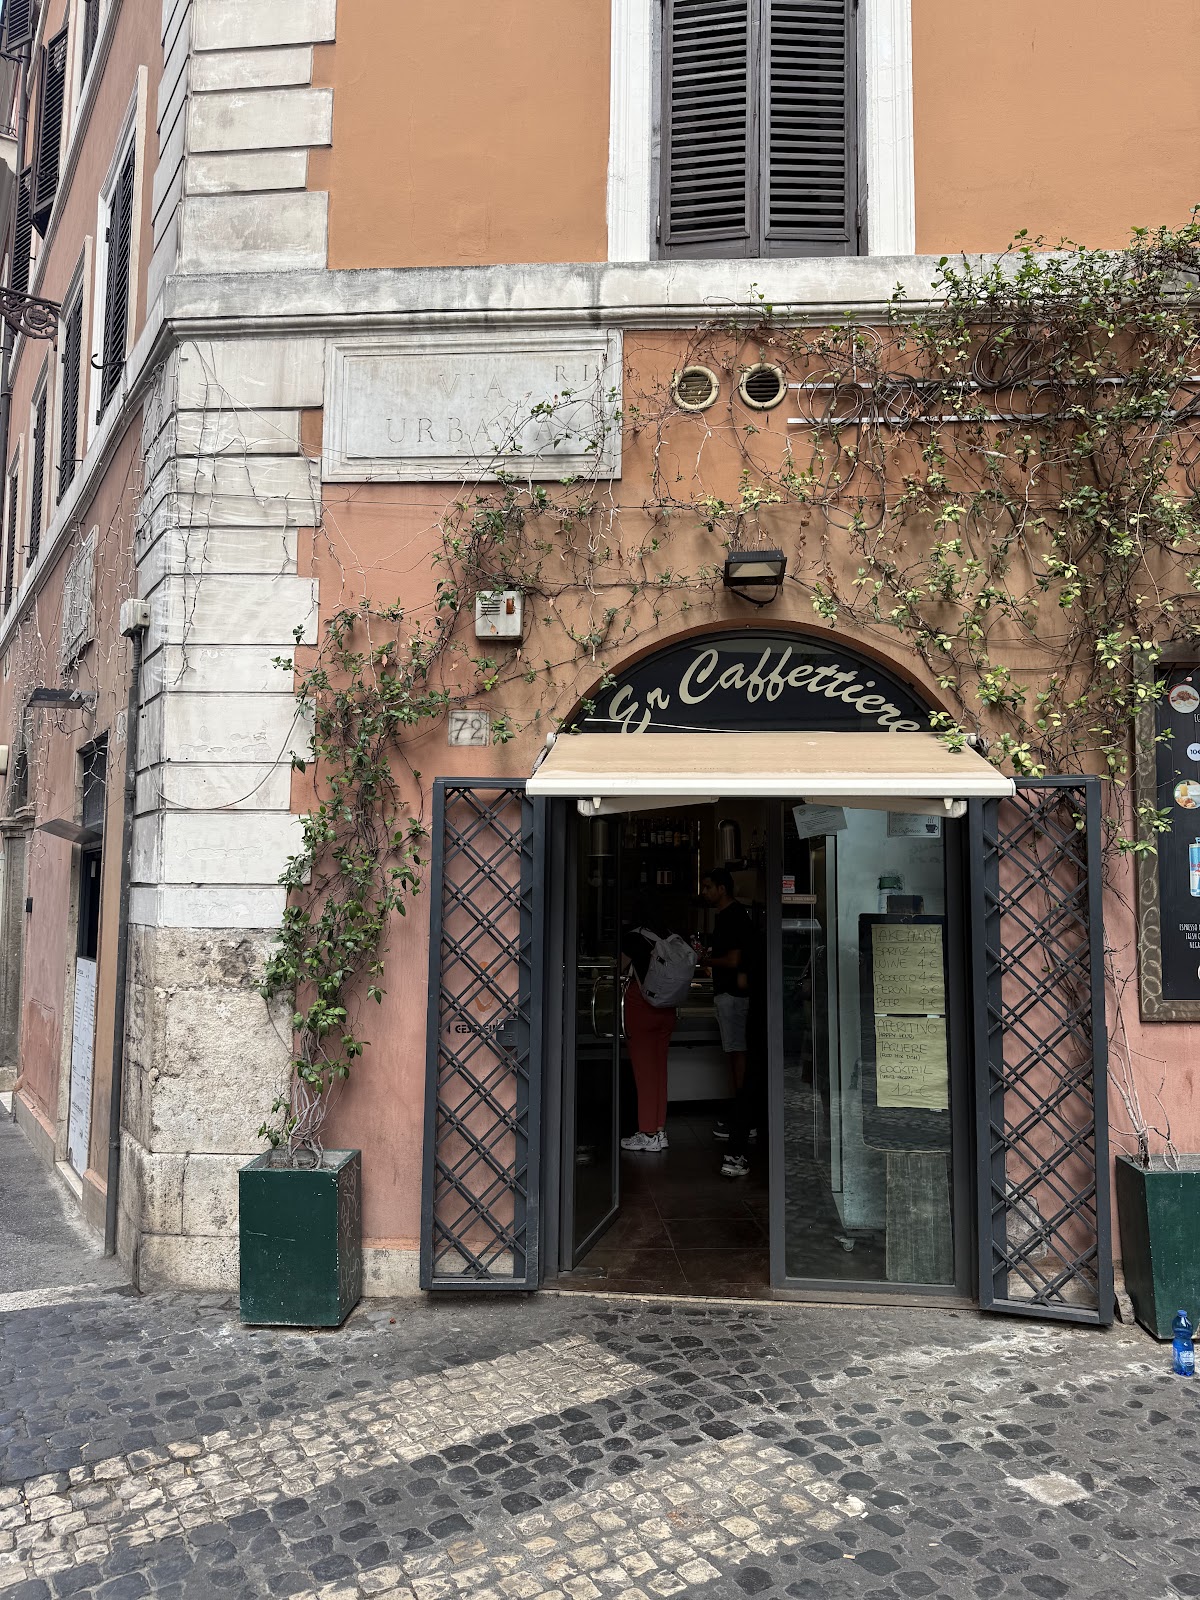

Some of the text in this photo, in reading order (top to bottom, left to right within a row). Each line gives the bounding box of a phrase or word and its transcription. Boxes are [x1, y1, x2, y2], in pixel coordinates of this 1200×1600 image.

[438, 373, 506, 399] VIA
[385, 416, 555, 444] URBANA
[678, 646, 921, 733] Caffettiere
[454, 718, 484, 741] 72
[875, 927, 941, 944] TAKE AWAY
[874, 946, 911, 956] SPRITZ
[874, 957, 908, 969] WINE
[873, 971, 917, 982] PROSECCO
[876, 1018, 938, 1034] APERITIVO
[879, 1064, 934, 1075] COCKTAIL
